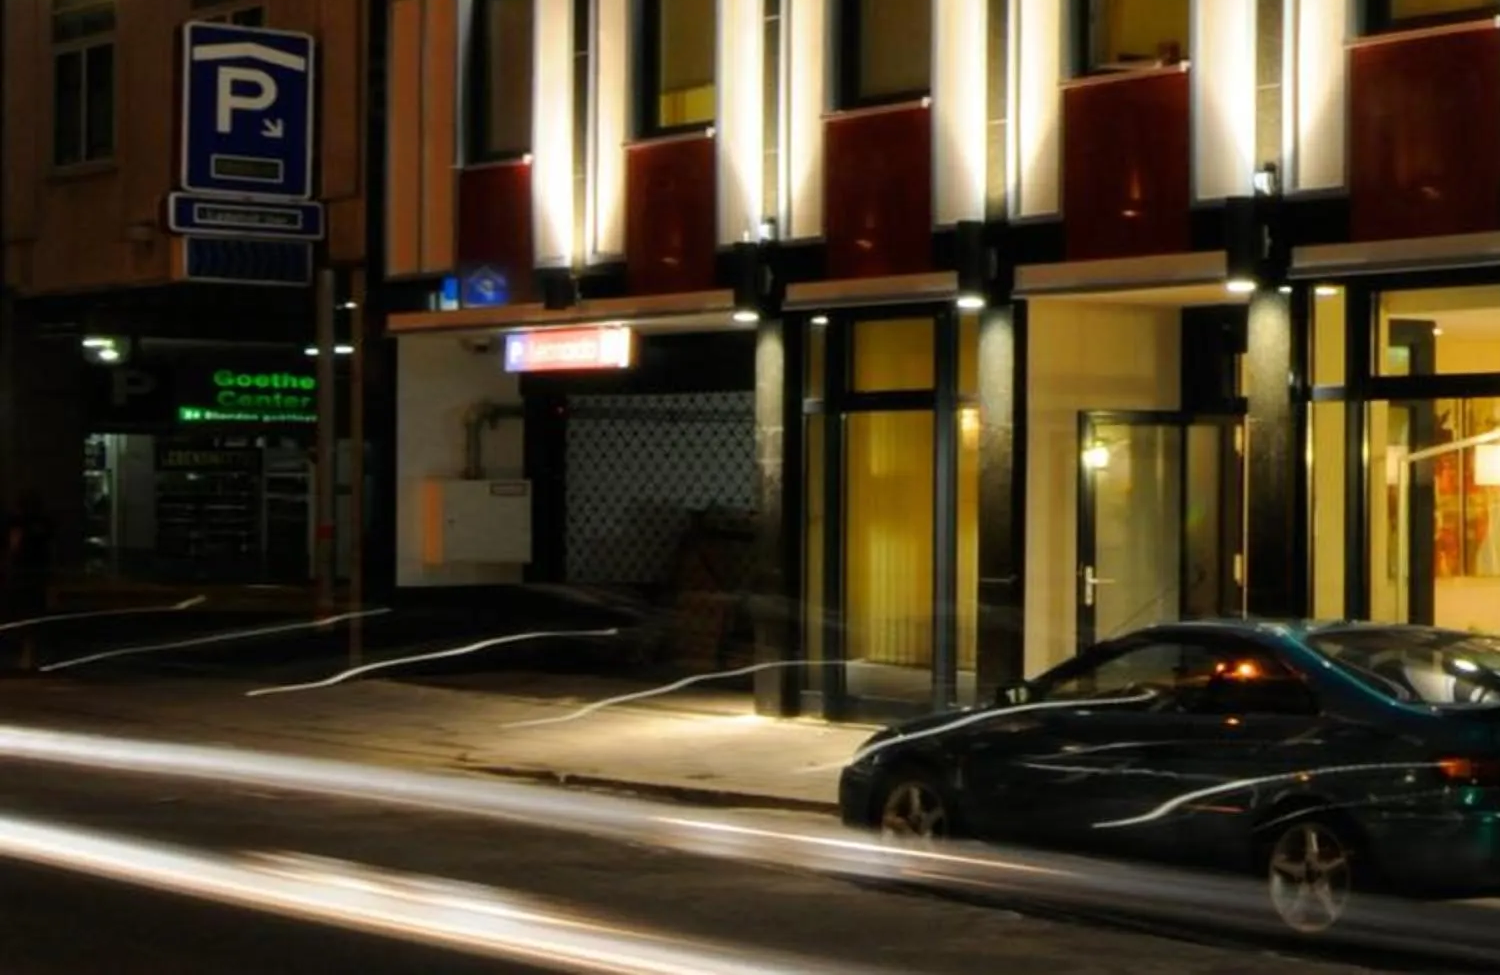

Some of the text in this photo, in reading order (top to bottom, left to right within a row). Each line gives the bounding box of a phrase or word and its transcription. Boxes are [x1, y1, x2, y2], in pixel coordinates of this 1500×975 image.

[216, 66, 278, 134] P
[213, 370, 317, 390] Goethe
[216, 390, 312, 409] Center
